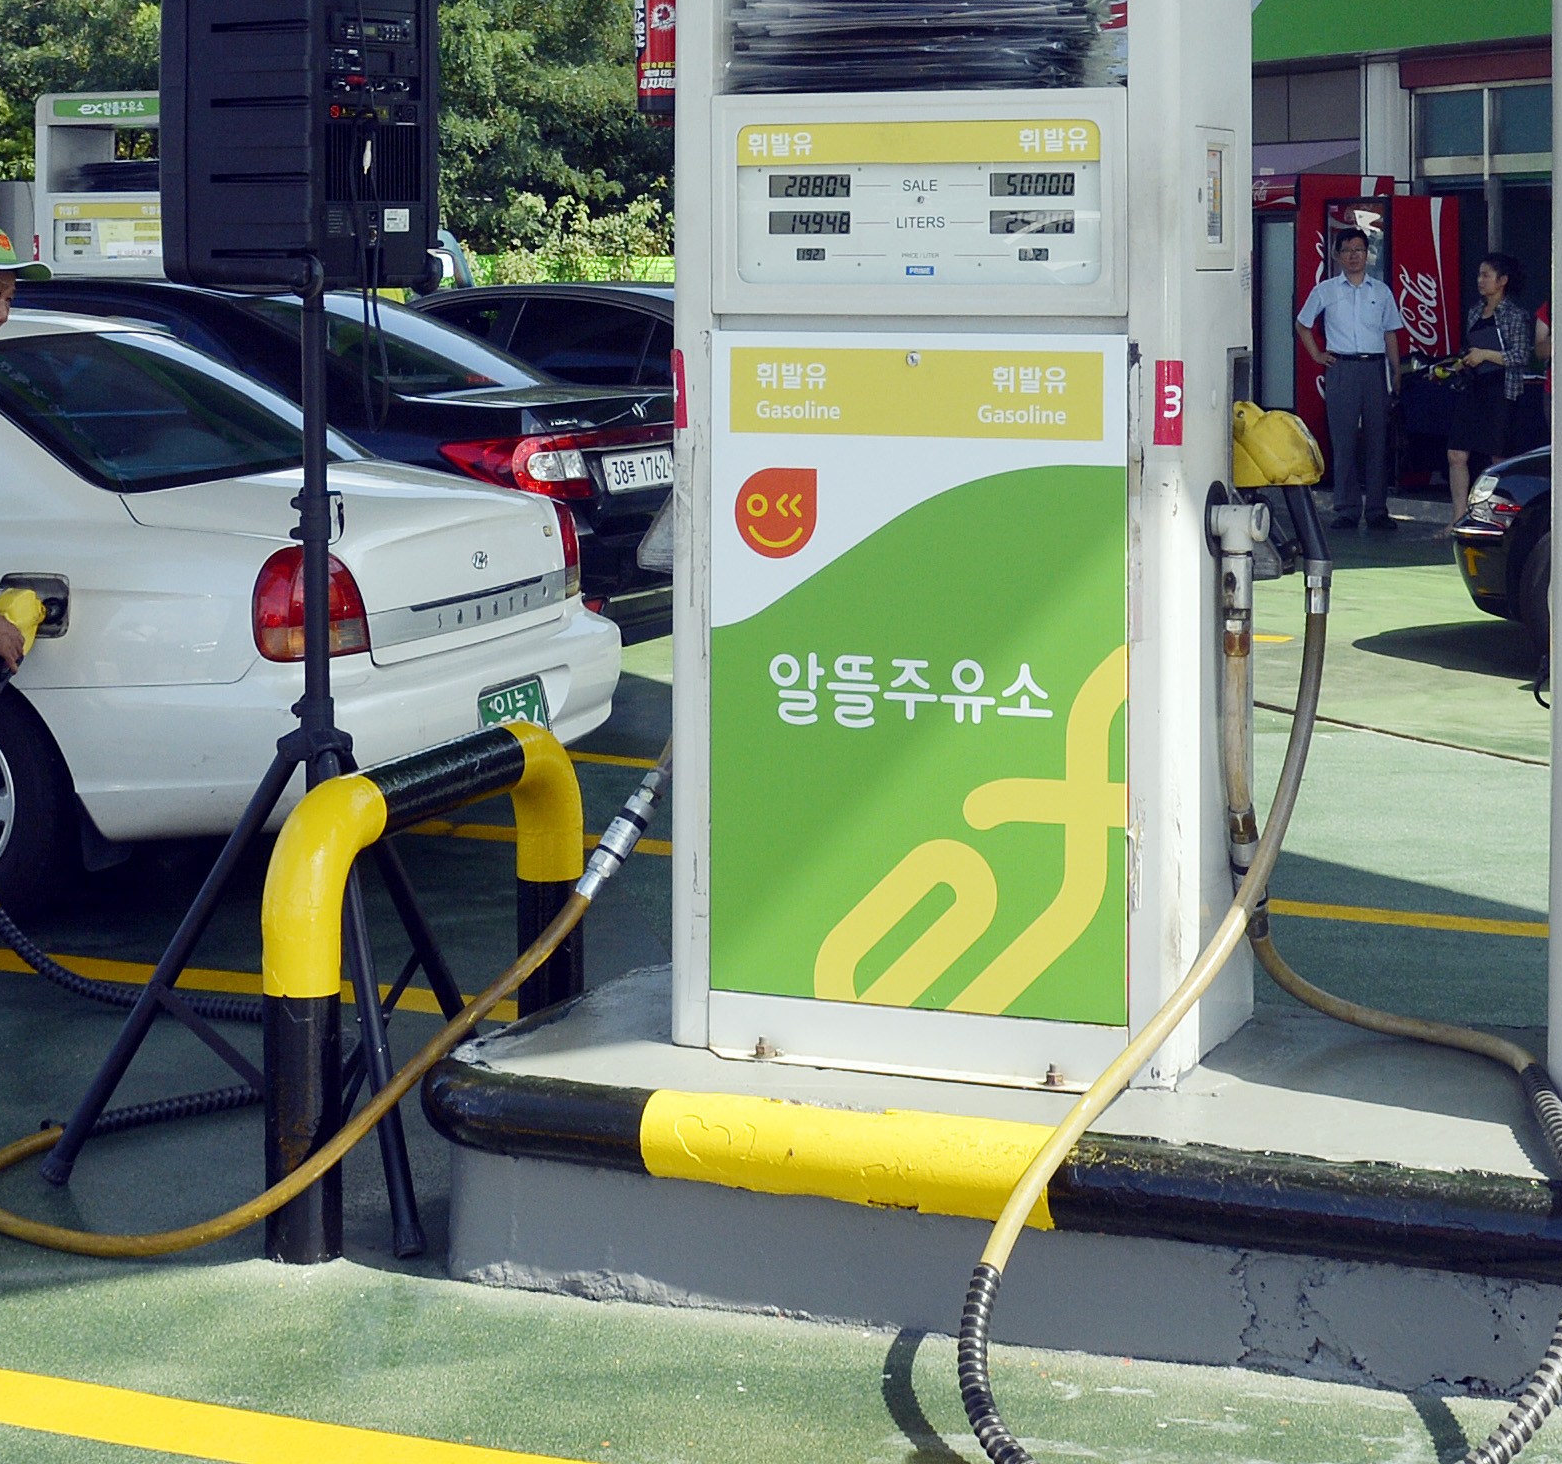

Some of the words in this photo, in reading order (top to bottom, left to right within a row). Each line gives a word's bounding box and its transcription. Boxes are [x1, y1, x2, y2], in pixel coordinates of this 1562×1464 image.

[747, 132, 813, 157] 휘발유
[1018, 127, 1089, 153] 휘발유
[901, 179, 938, 192] SALE
[1007, 173, 1075, 196] 50000
[896, 215, 946, 230] LITERS
[755, 361, 828, 391] 휘발유
[991, 365, 1068, 395] 휘발유
[755, 400, 841, 422] Gasoline
[1163, 385, 1184, 418] 3
[976, 404, 1068, 427] Gasoline
[640, 455, 669, 482] 1762
[769, 651, 1054, 730] 알뜰주유소
